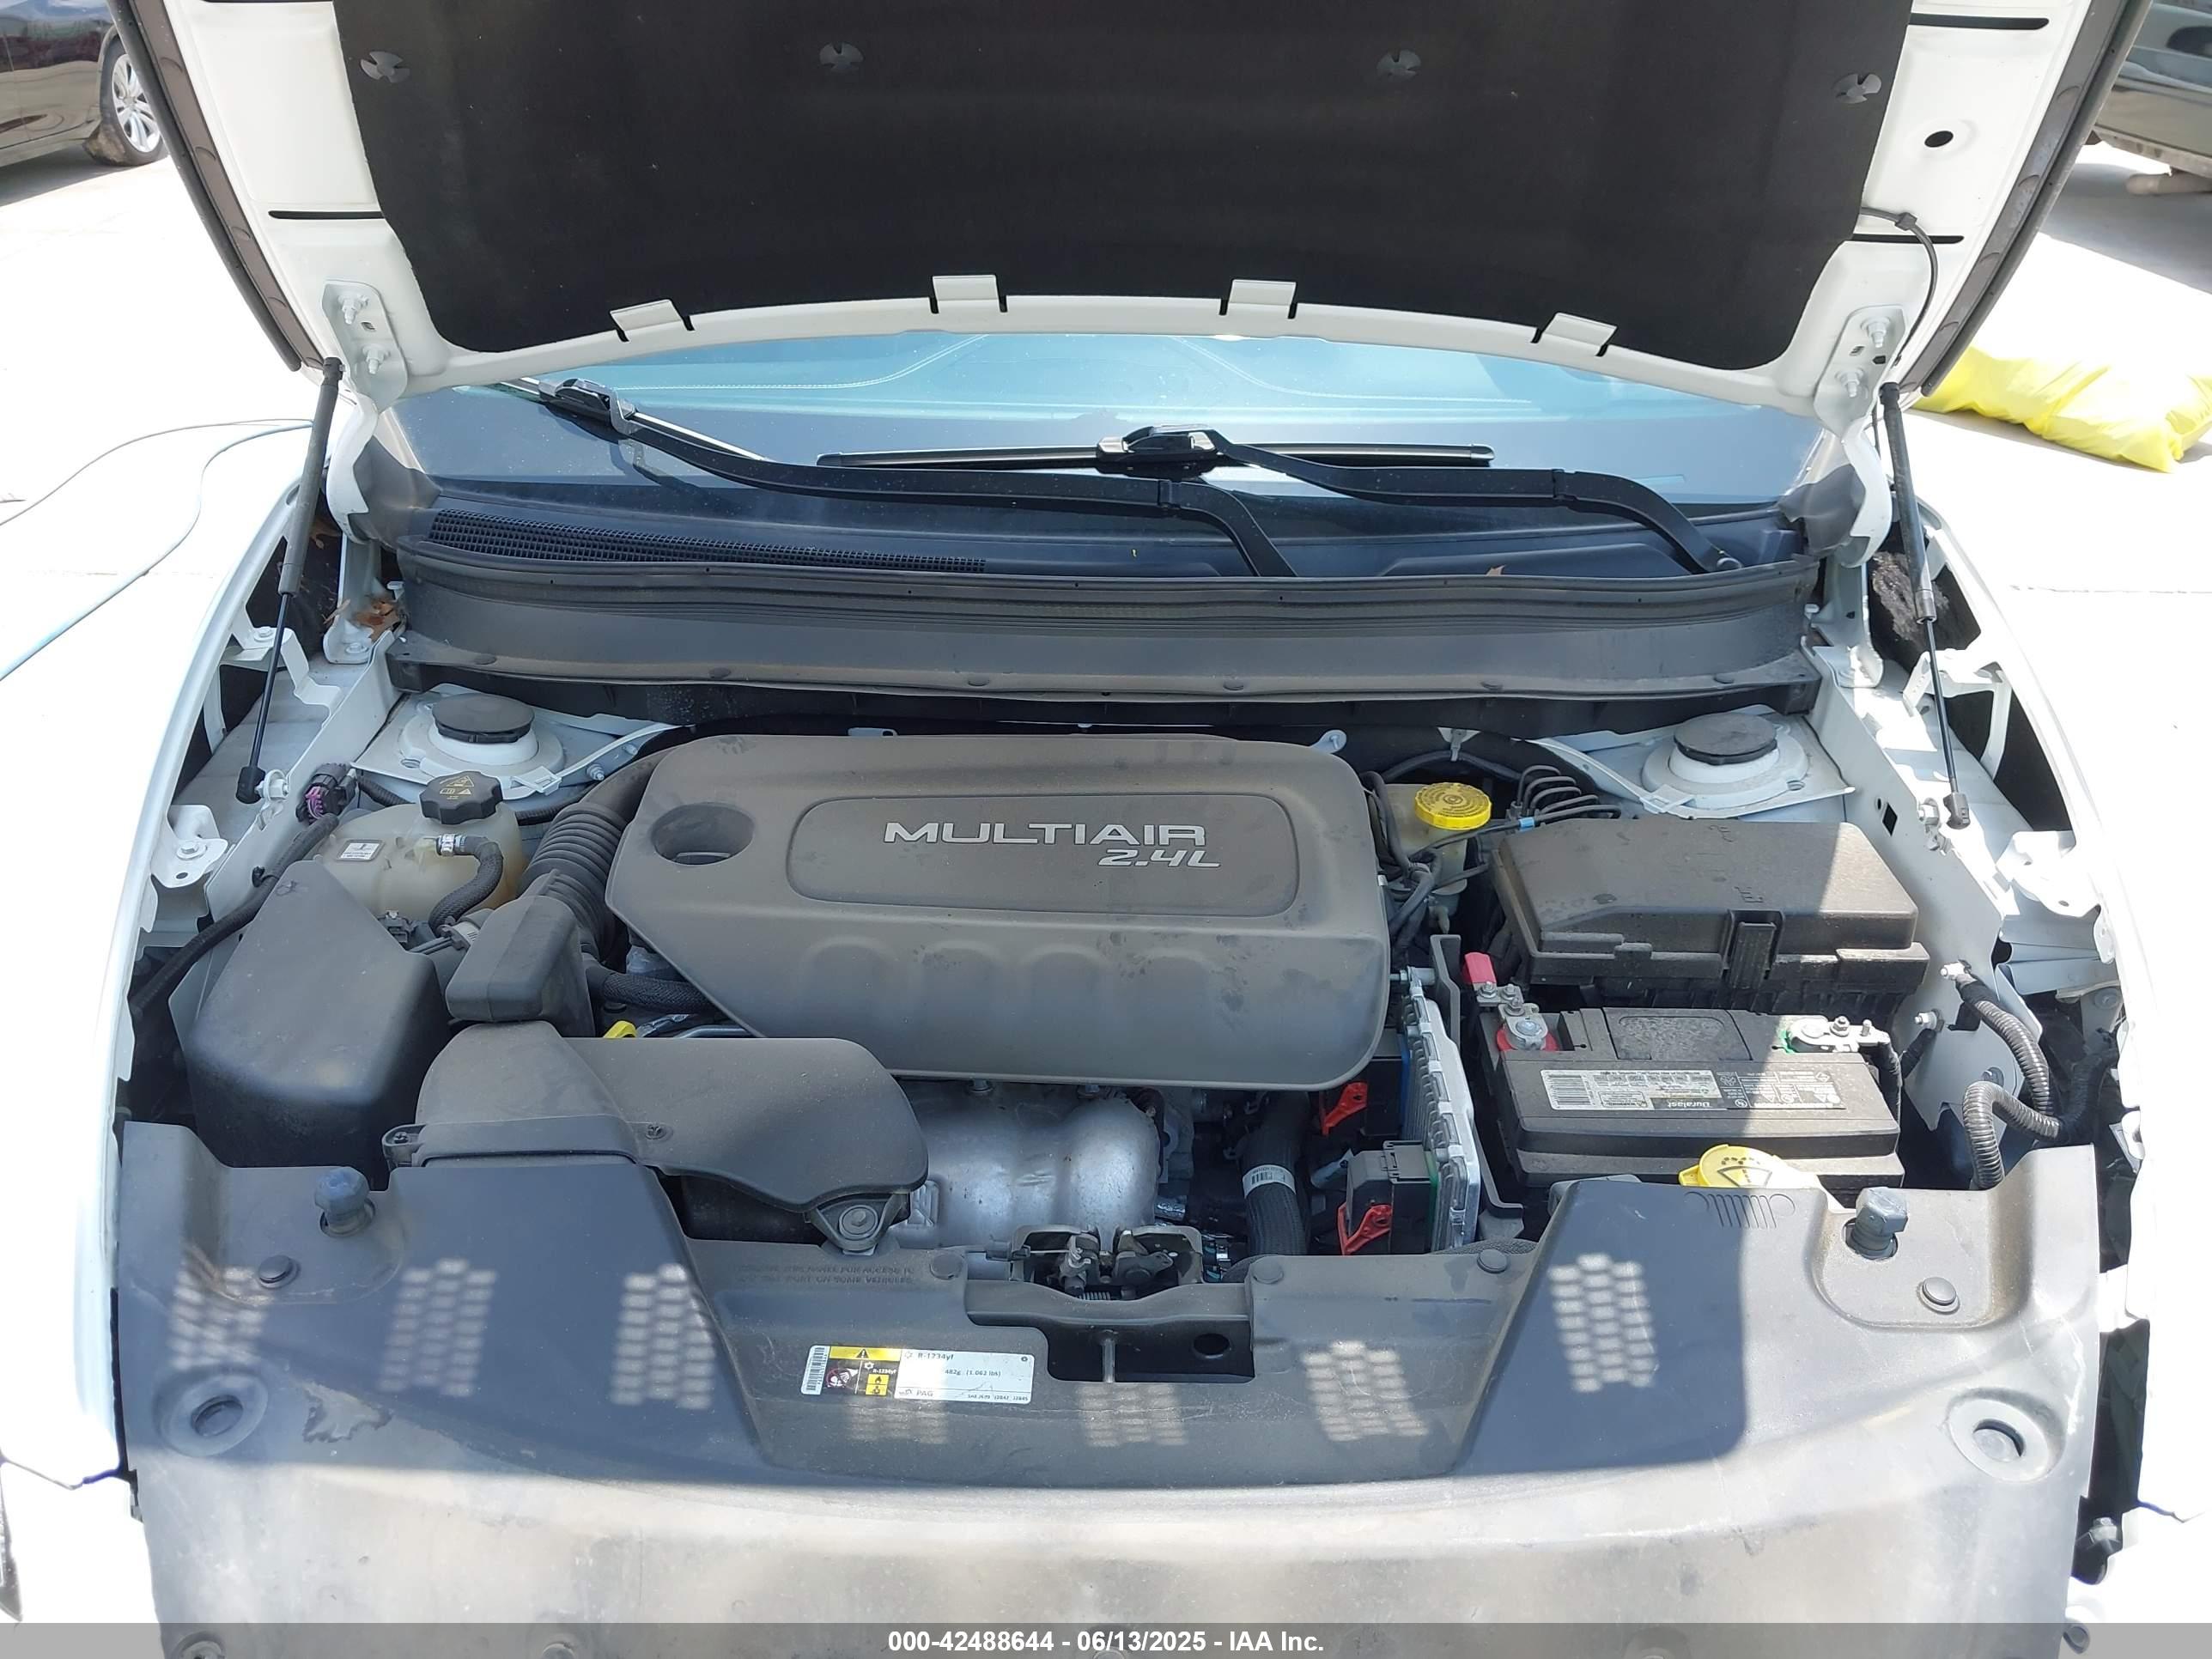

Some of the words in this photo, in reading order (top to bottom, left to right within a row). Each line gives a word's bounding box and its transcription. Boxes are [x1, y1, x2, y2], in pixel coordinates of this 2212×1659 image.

[883, 822, 1206, 847] MULTIAIR
[1097, 848, 1221, 868] 2.4L
[917, 1352, 955, 1361] R-1234yf
